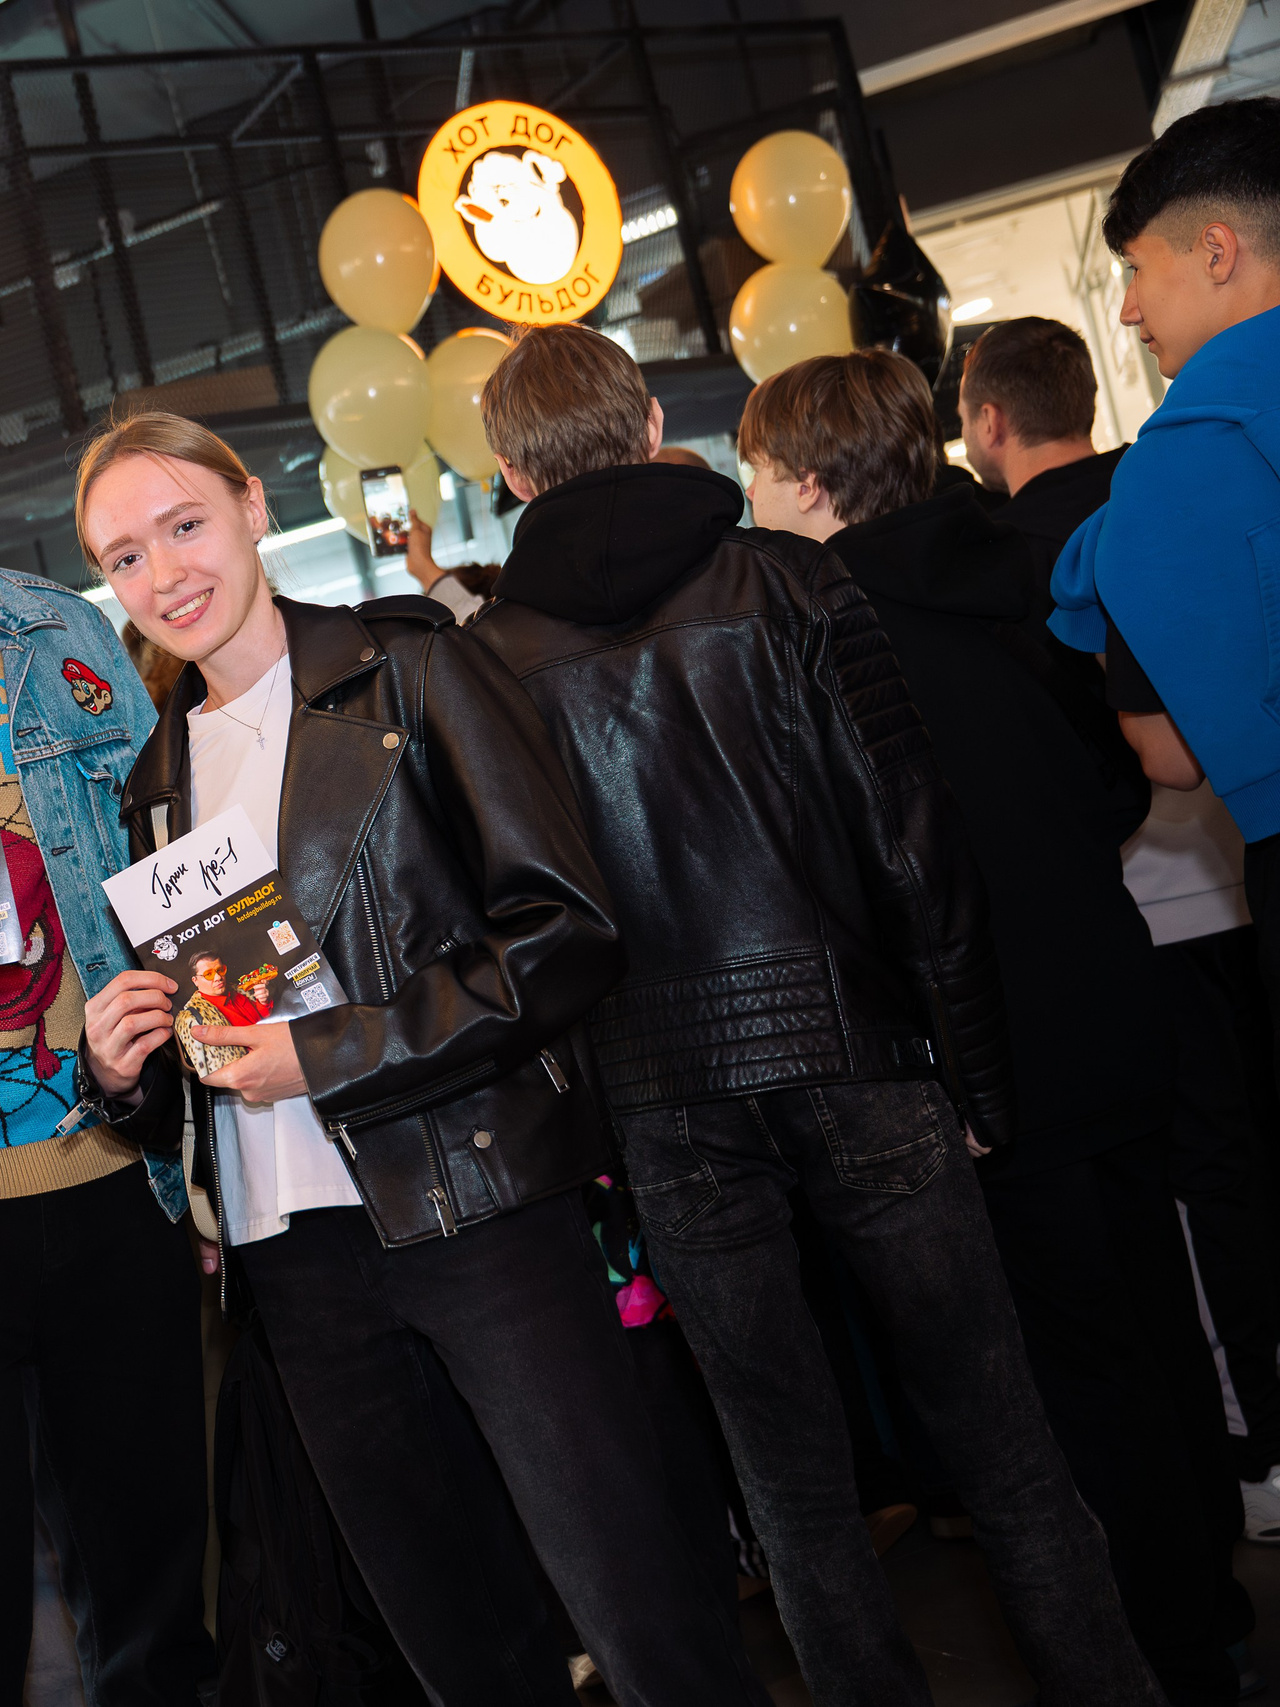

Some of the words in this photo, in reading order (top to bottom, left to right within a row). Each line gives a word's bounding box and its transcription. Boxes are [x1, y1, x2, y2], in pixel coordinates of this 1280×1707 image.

[443, 116, 490, 163] ХОТ
[510, 115, 572, 150] ДОГ
[476, 263, 600, 314] БУЛЬДОГ
[176, 924, 201, 944] ХОТ
[203, 910, 226, 931] ДОГ
[226, 881, 276, 917] БУЛЬДОГ
[236, 894, 283, 923] hotdogbulldog.ru
